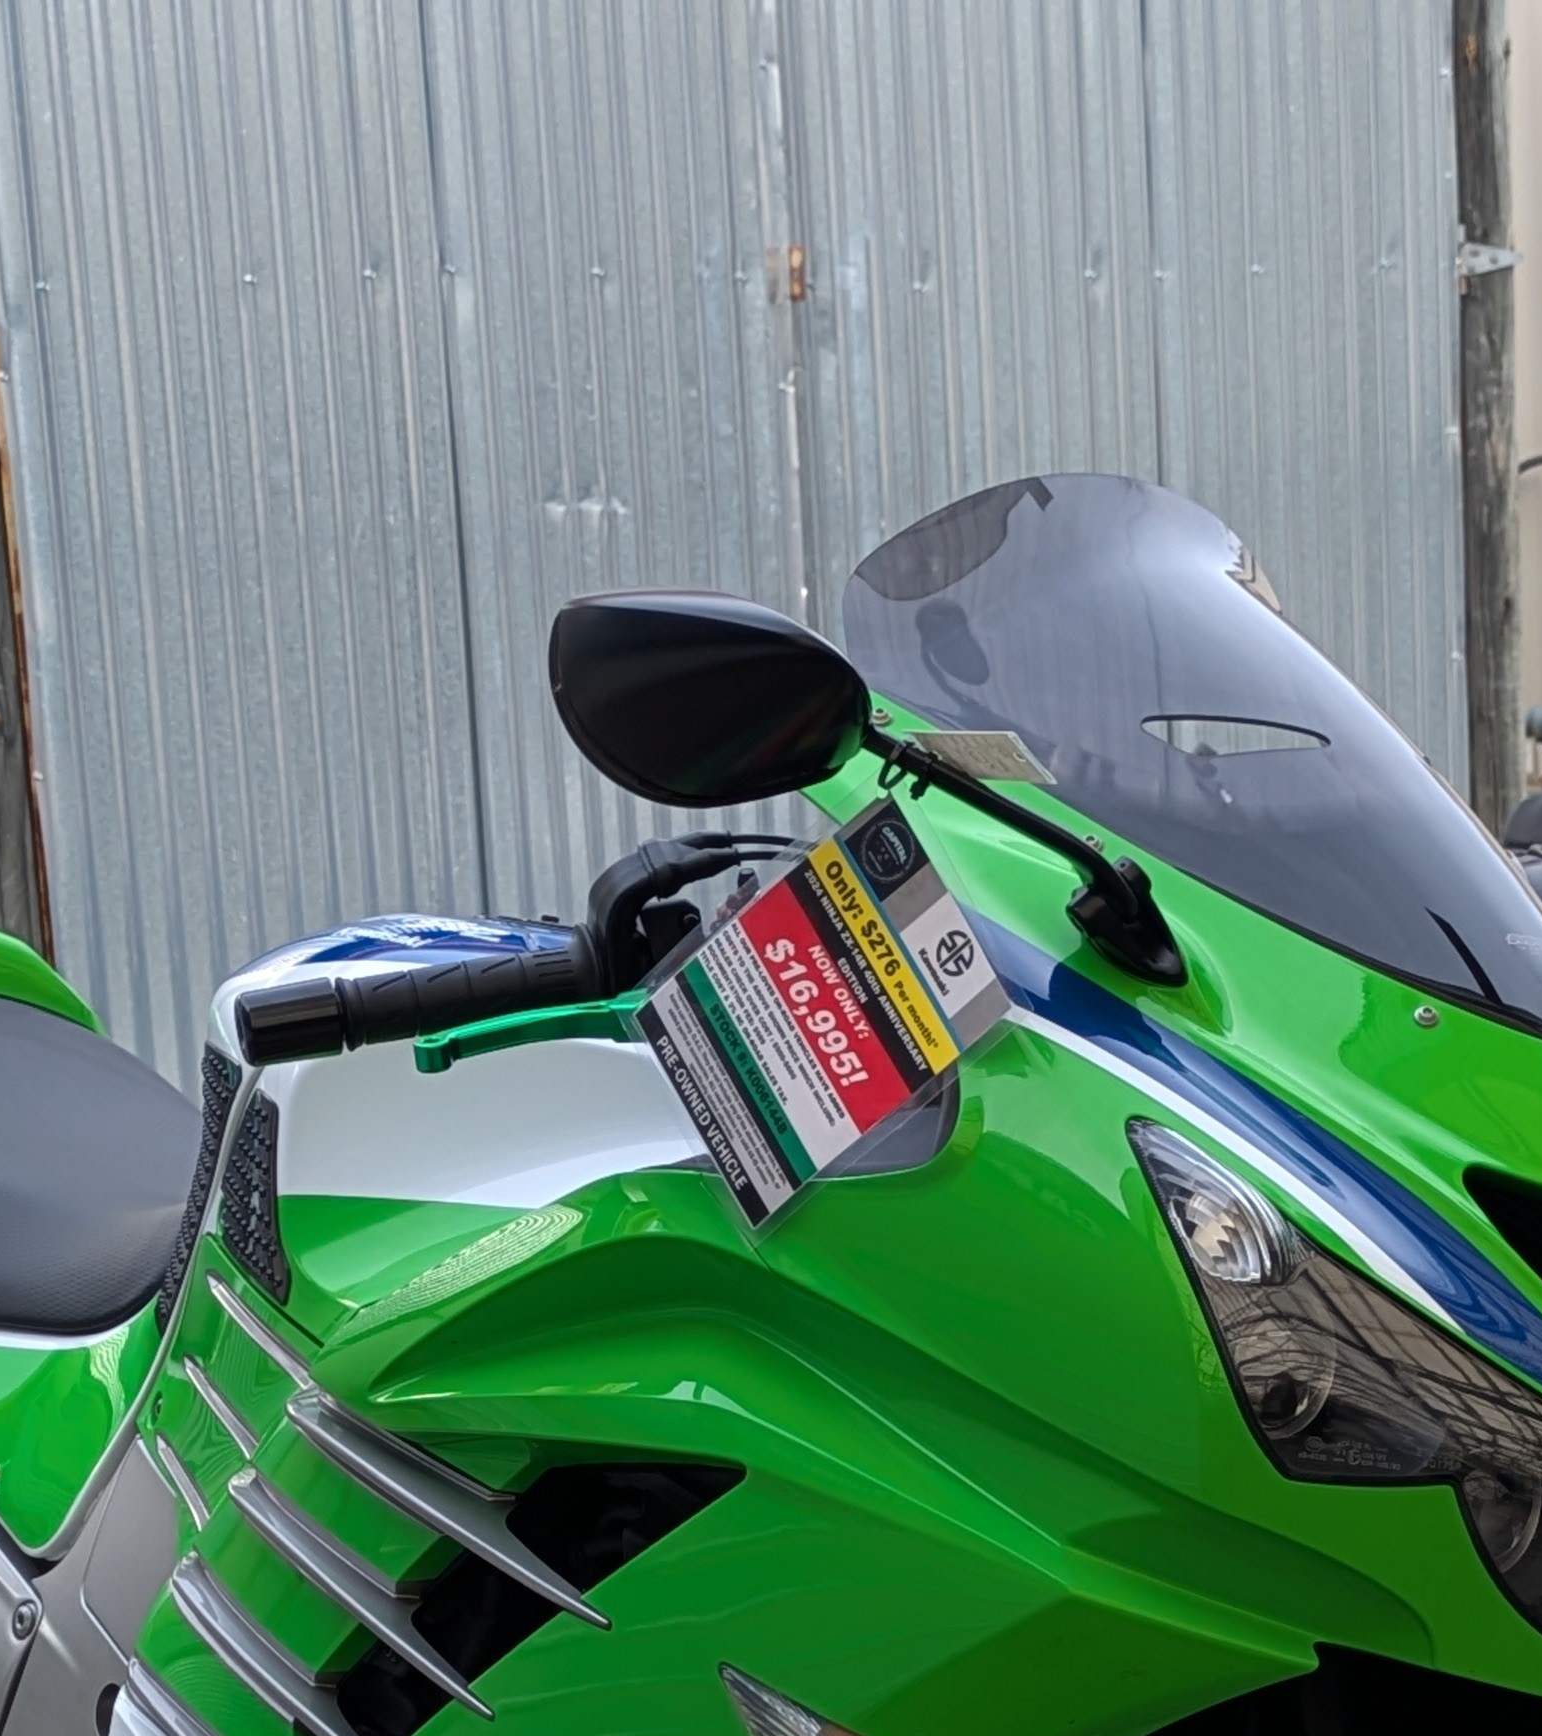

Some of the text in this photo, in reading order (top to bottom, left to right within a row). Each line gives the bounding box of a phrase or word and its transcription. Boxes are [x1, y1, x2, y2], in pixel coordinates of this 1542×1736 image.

[881, 826, 907, 863] CAPITAL
[823, 857, 865, 920] Only:
[859, 917, 901, 979] $276
[892, 979, 911, 1005] Per
[706, 943, 745, 1009] DOCUMENTATION
[730, 966, 748, 994] CHECK
[745, 993, 760, 1016] OVER
[757, 1015, 772, 1037] COST
[803, 867, 928, 1074] 2024 NINJA ZX-14R 40th ANNIVERSARY
[807, 945, 869, 1039] NOW ONLY:
[836, 956, 868, 1004] EDITION
[917, 946, 949, 997] Kawasaki
[709, 1002, 741, 1053] STOCK
[736, 955, 746, 968] TO
[743, 967, 755, 984] THE
[784, 1038, 800, 1063] PRICE
[764, 936, 869, 1087] $16,995!
[793, 1030, 817, 1070] VEHICLES
[655, 1033, 712, 1128] PRE-OWNED
[704, 1121, 748, 1192] VEHICLE
